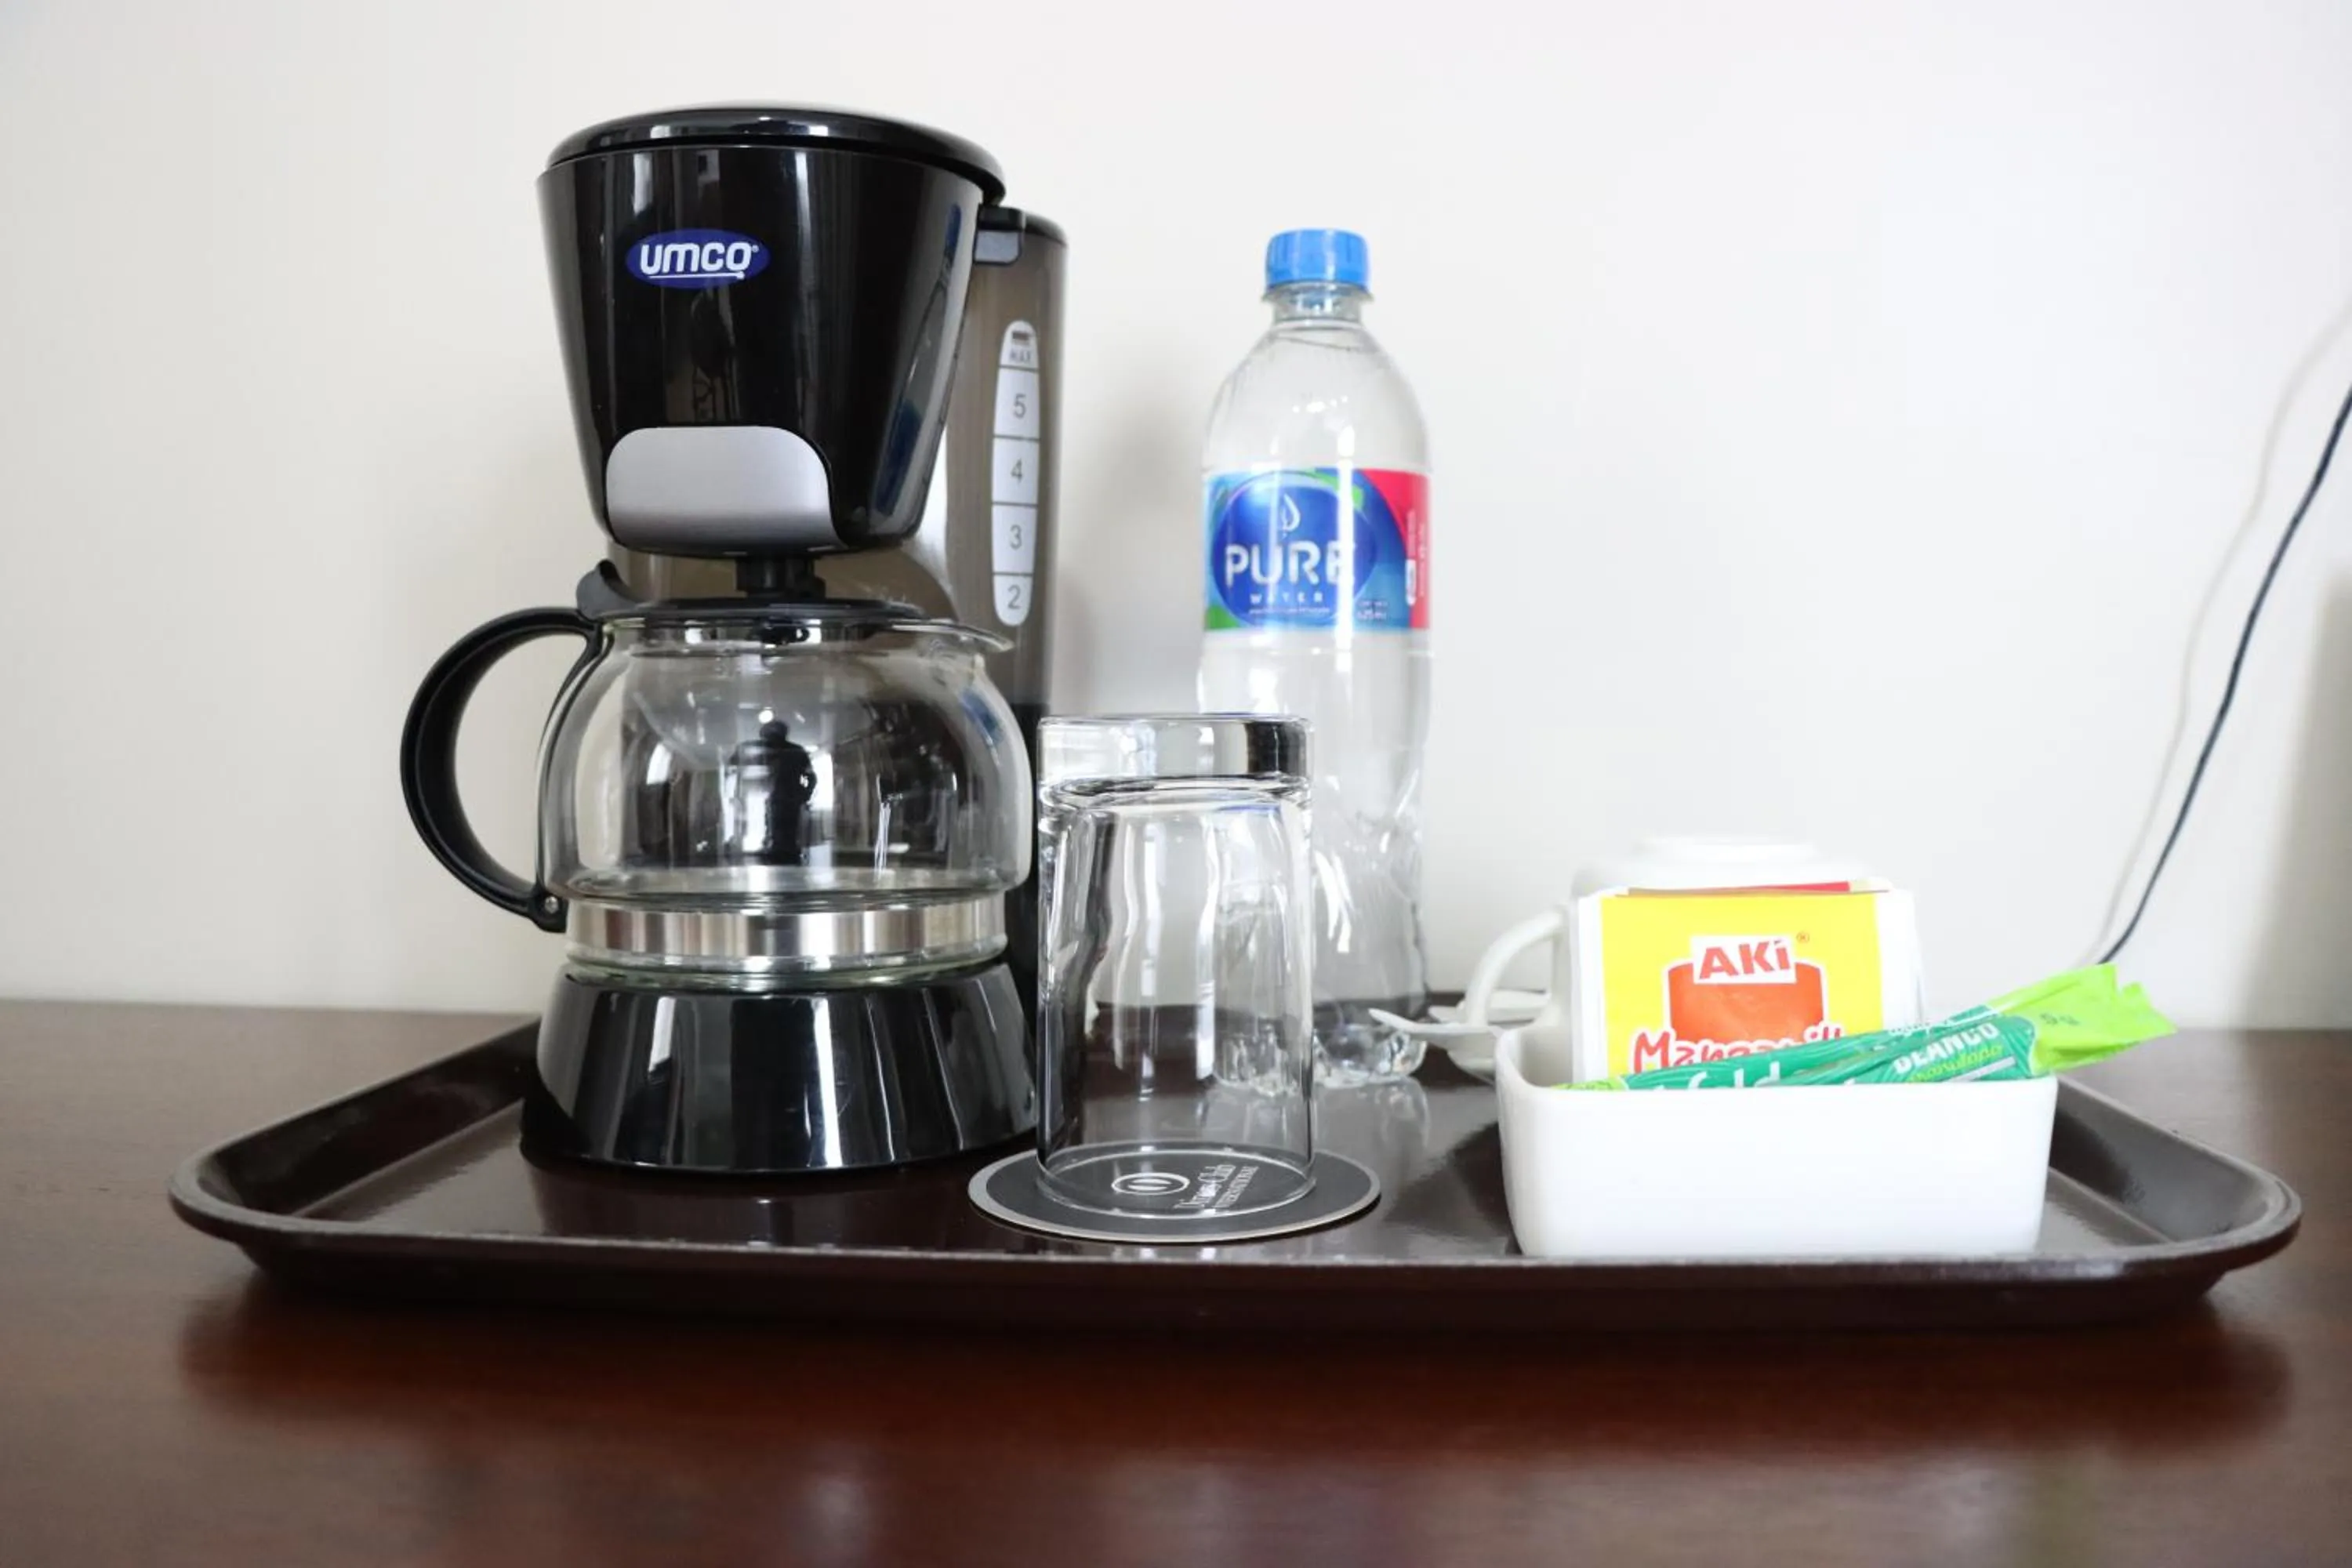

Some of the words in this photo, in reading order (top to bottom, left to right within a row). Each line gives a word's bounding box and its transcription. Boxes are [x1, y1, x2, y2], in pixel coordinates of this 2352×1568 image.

[1013, 393, 1027, 419] 5
[1011, 459, 1023, 483] 4
[1010, 524, 1023, 551] 3
[1007, 585, 1022, 610] 2
